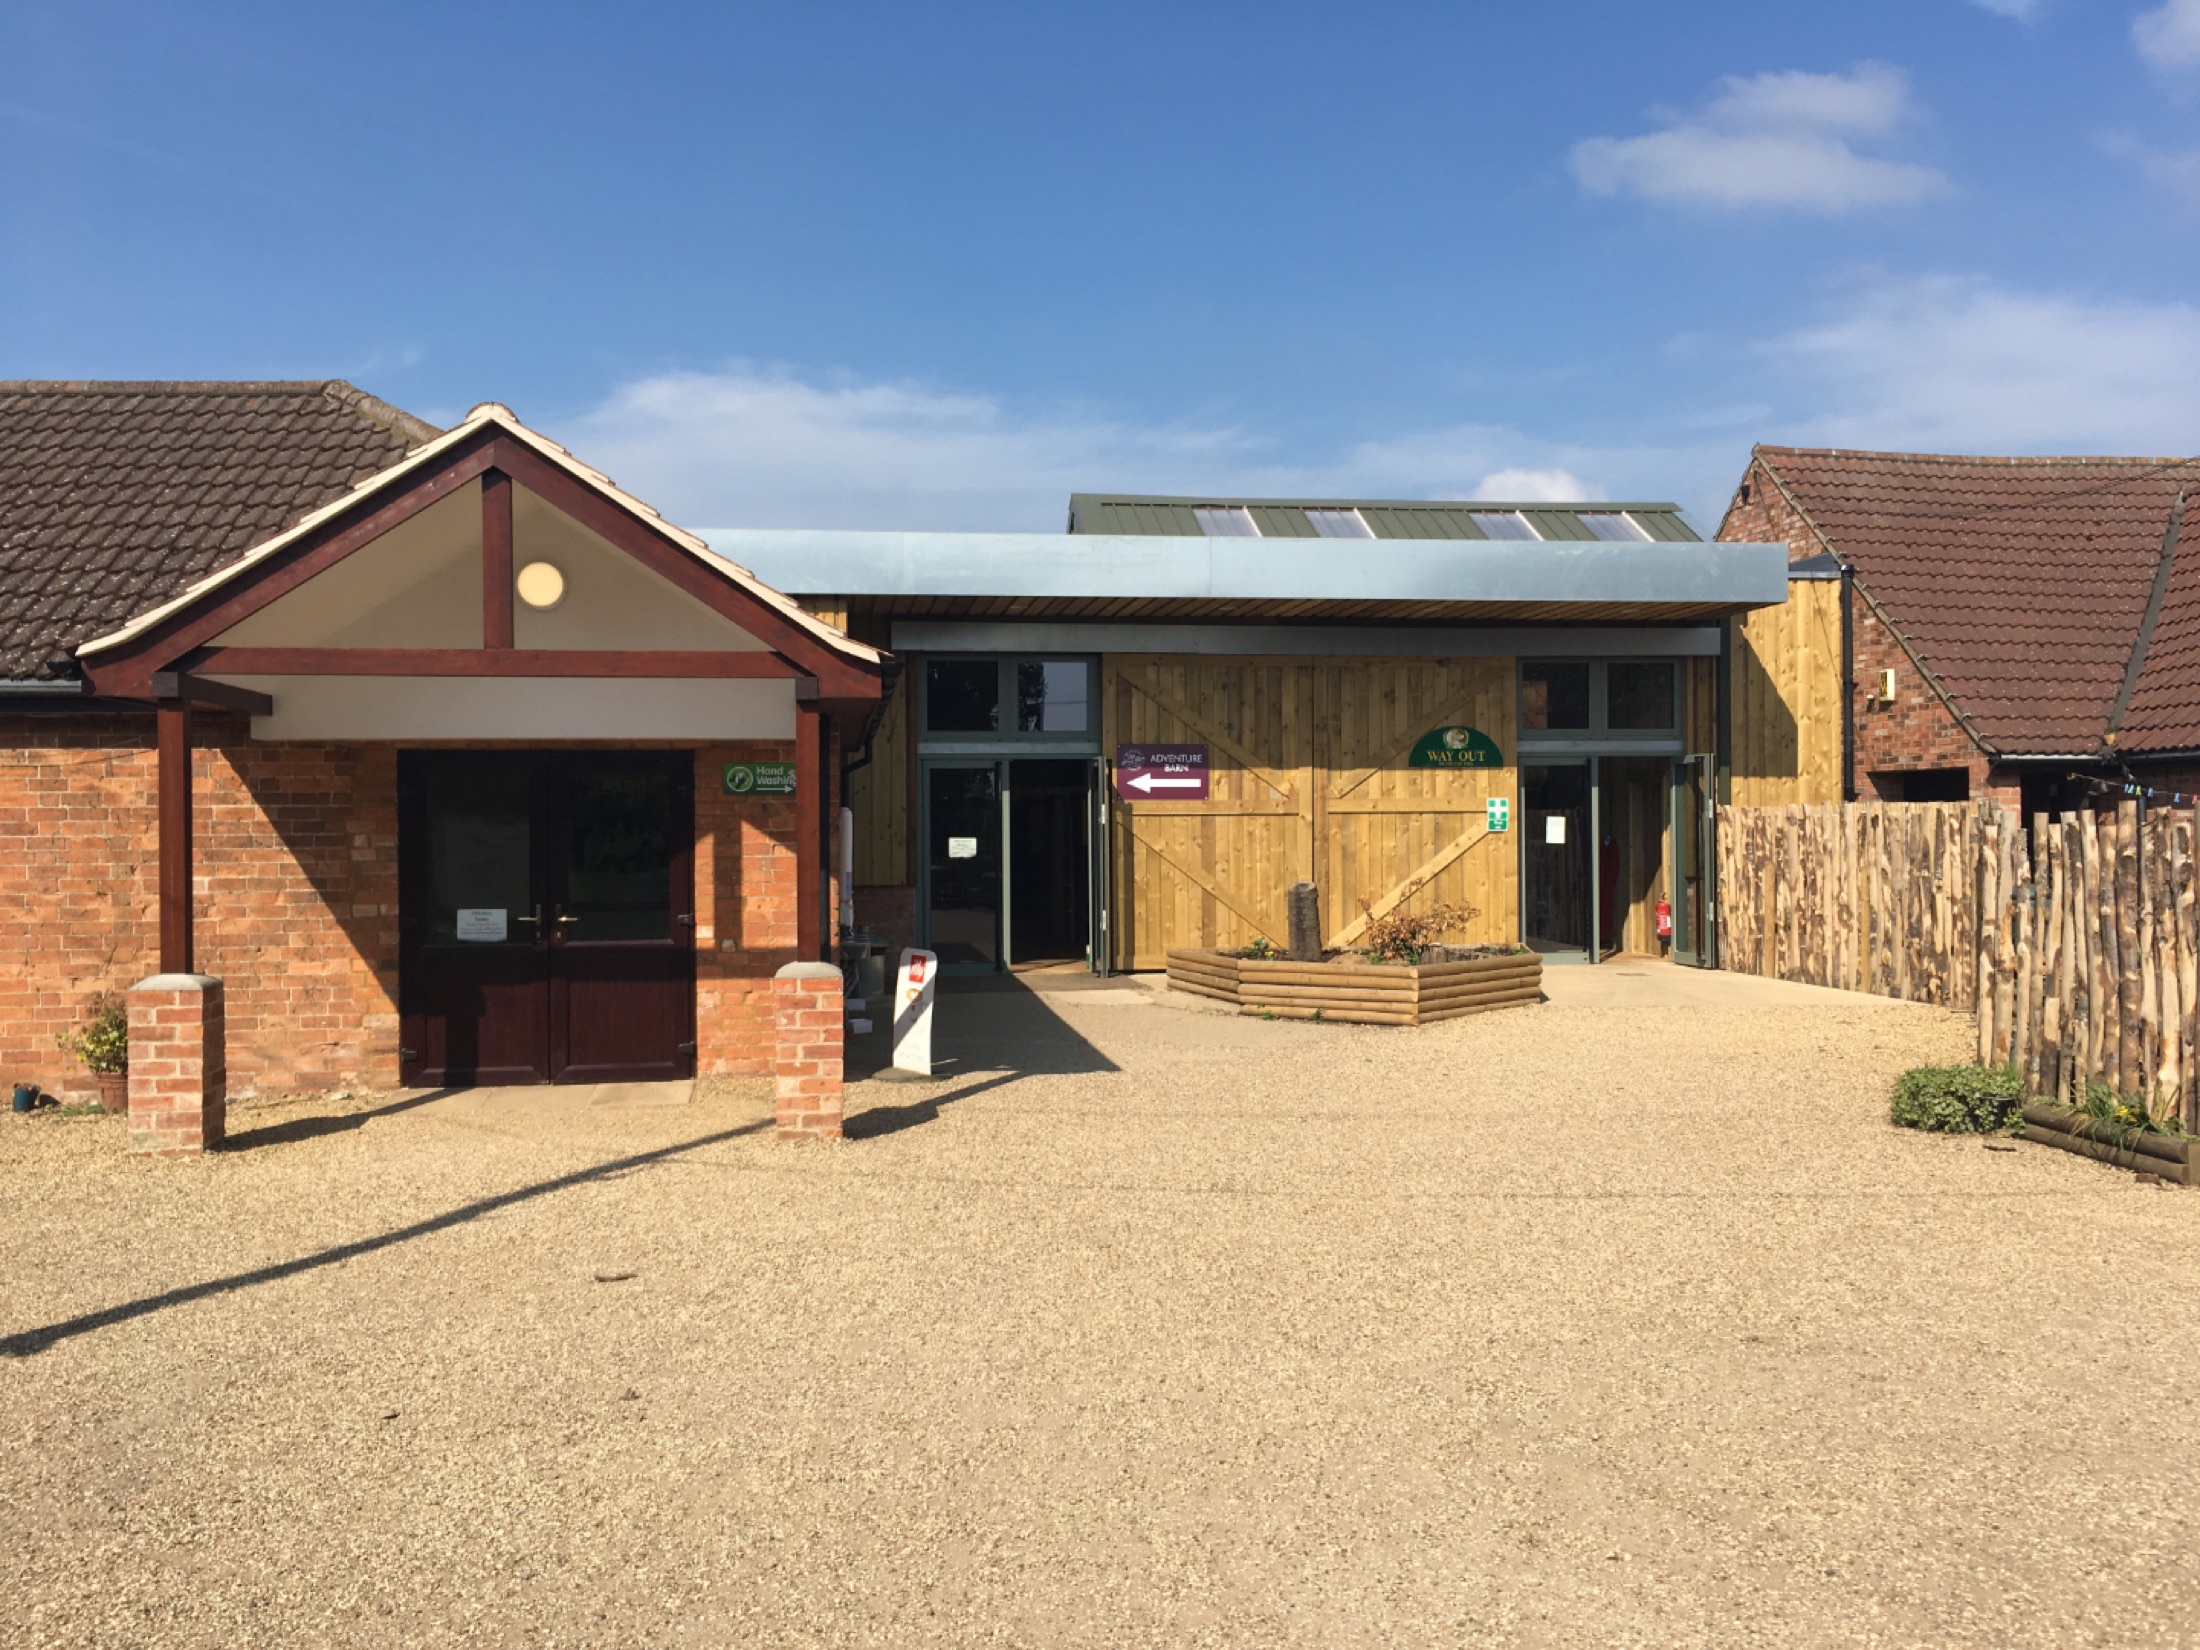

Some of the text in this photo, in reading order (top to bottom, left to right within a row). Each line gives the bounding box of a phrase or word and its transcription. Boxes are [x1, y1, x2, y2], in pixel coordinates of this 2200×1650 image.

[1150, 754, 1203, 763] ADVENTURE
[1427, 750, 1485, 762] WAY OUT
[756, 766, 784, 775] Hand
[1164, 764, 1189, 772] BARN
